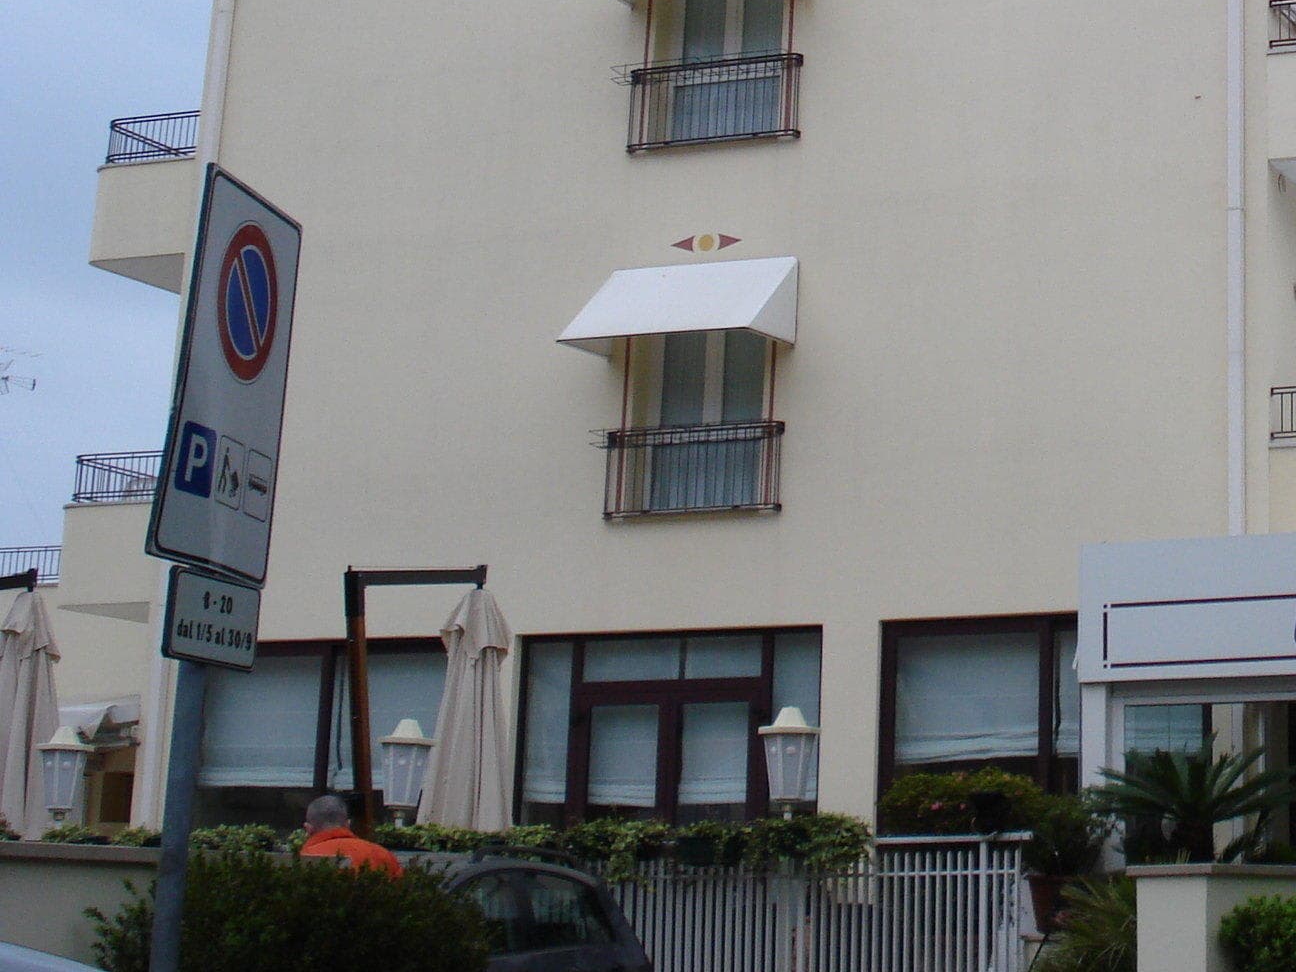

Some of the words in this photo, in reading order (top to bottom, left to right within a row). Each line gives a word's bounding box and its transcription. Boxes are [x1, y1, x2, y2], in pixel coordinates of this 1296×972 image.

[184, 432, 208, 483] P
[220, 595, 233, 615] 20
[177, 619, 194, 639] dal
[196, 622, 213, 643] 1/5
[214, 627, 225, 646] al
[228, 629, 252, 651] 30/9
